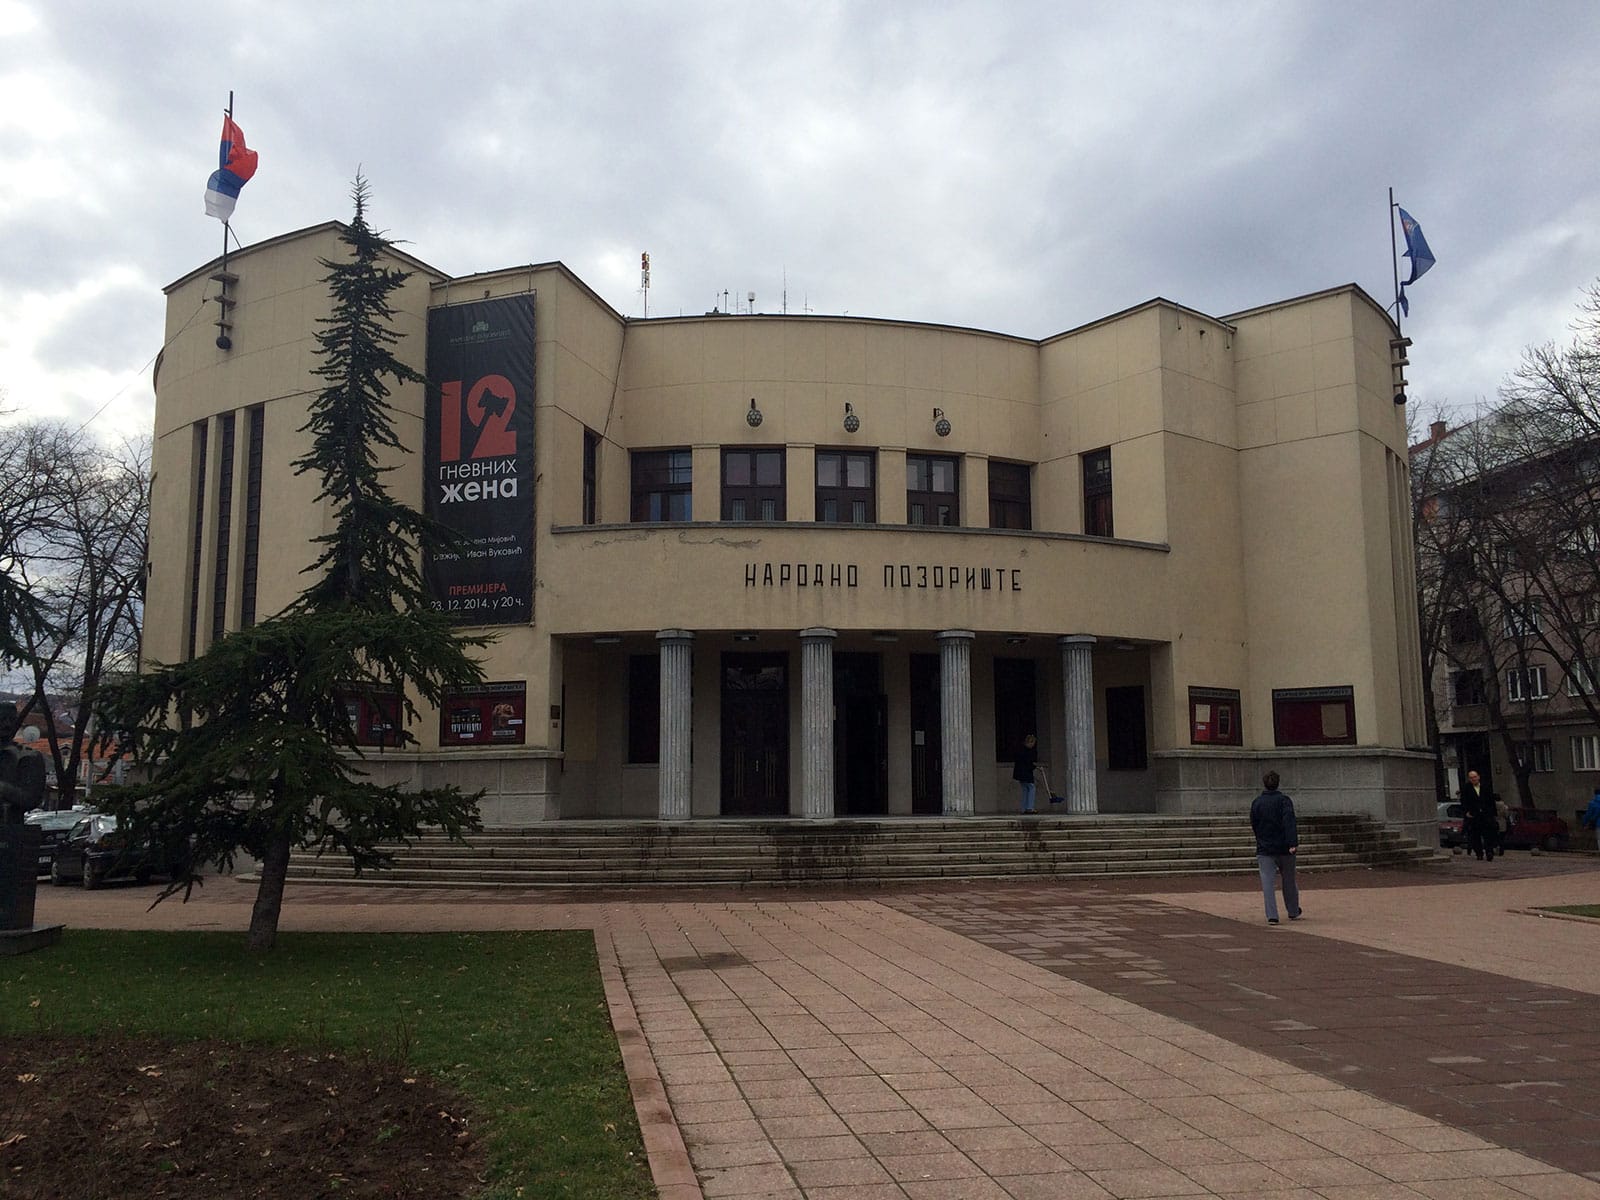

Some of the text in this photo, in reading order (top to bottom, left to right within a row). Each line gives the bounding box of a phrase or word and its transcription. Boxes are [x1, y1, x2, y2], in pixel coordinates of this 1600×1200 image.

[440, 374, 517, 462] 12
[440, 459, 517, 480] гневних
[440, 477, 518, 504] жена
[466, 550, 487, 558] Иван
[488, 546, 523, 558] Вуковић
[745, 563, 1022, 591] НАРОДНО ПОЗОРИШТЕ
[449, 583, 507, 596] ПРЕМИЈЕРА
[464, 598, 490, 610] 2014.
[492, 599, 499, 610] у
[500, 596, 514, 607] 20
